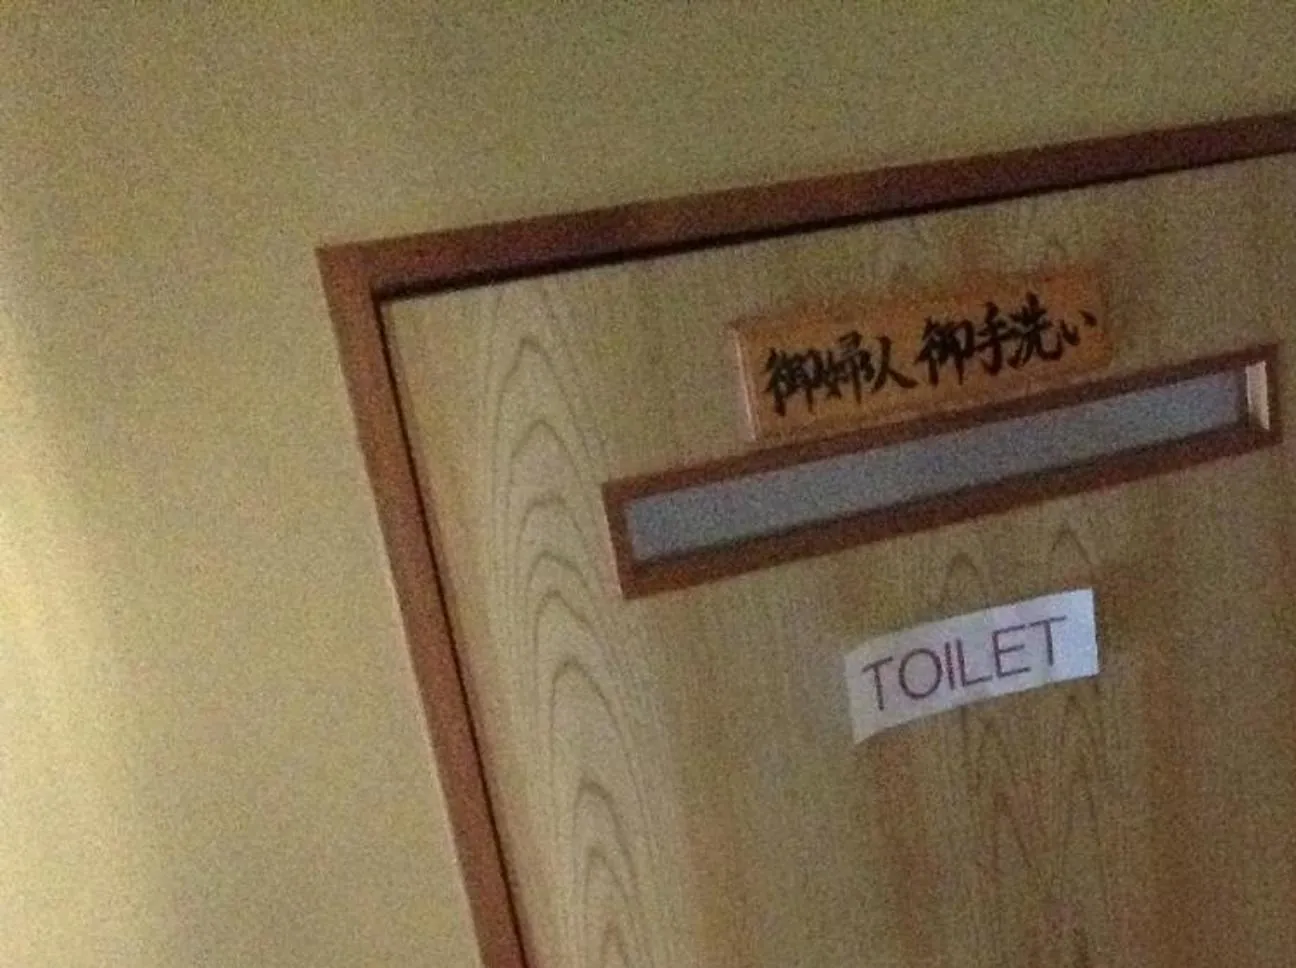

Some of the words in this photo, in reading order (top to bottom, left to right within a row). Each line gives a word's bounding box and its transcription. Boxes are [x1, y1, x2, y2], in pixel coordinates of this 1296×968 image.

[915, 292, 1096, 386] 御手洗い
[861, 614, 1067, 712] TOILET
